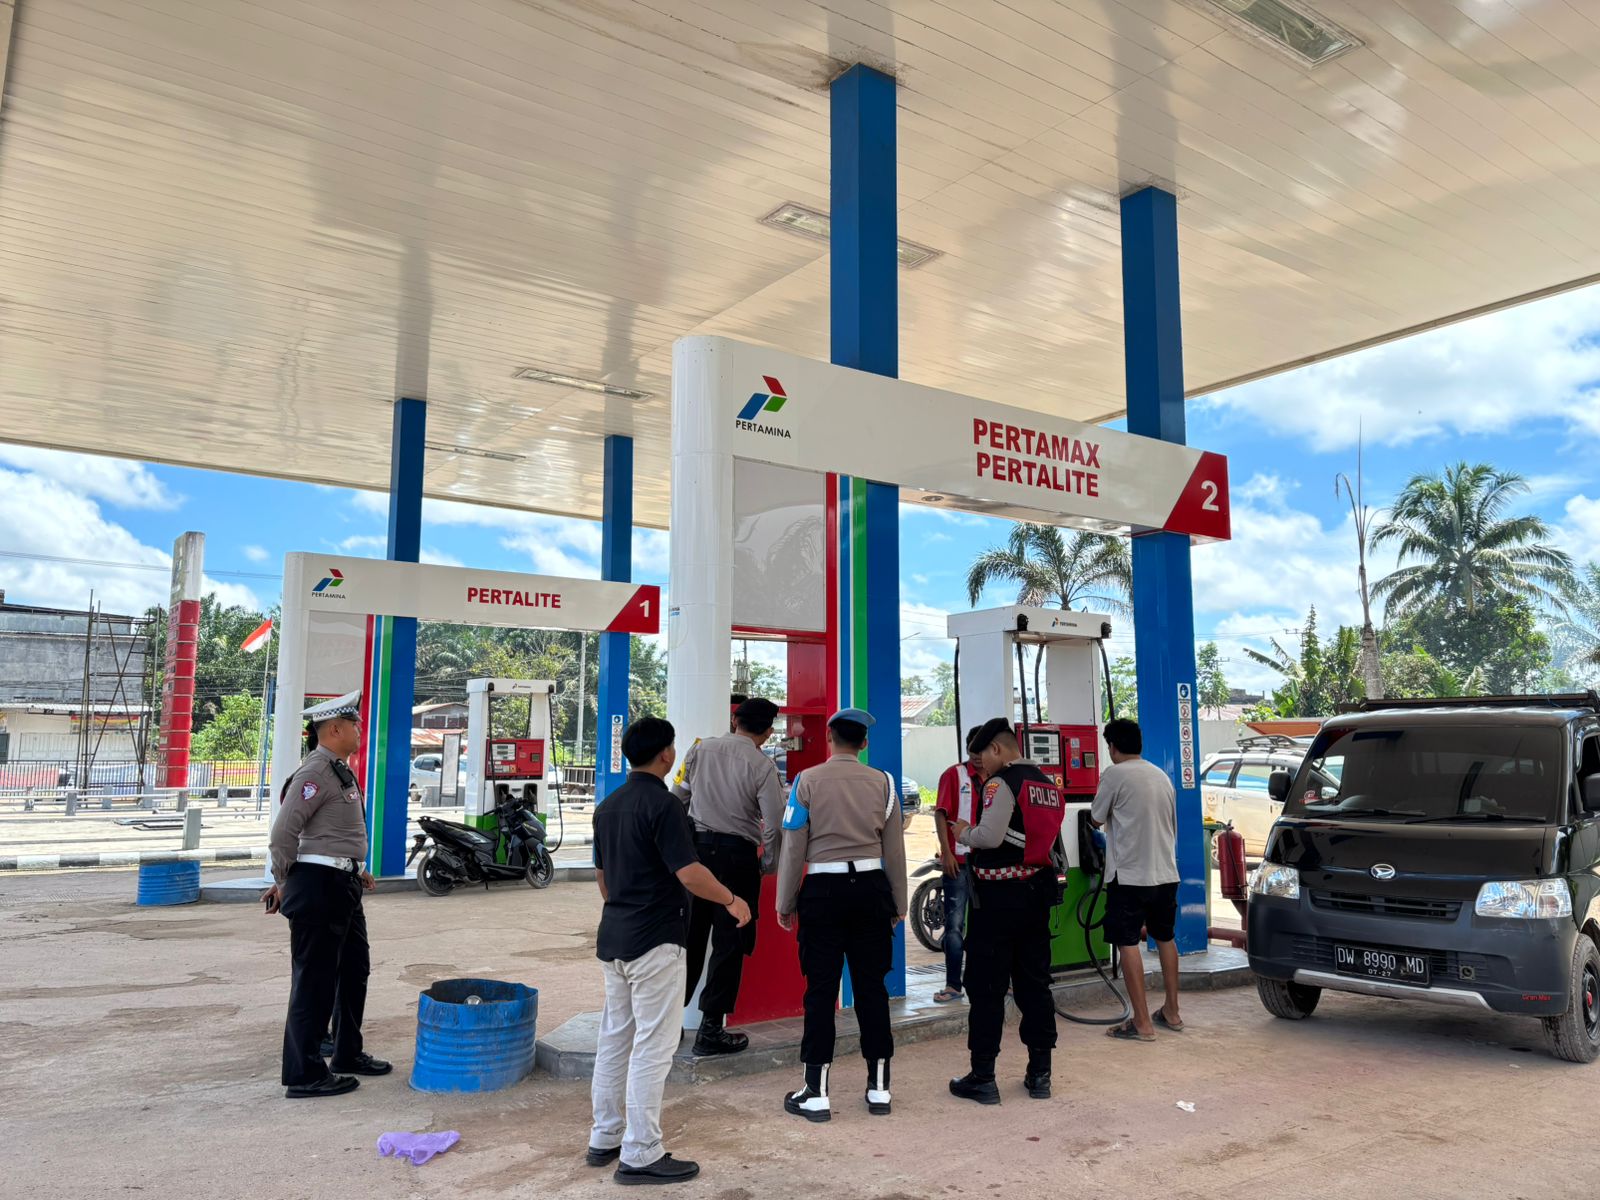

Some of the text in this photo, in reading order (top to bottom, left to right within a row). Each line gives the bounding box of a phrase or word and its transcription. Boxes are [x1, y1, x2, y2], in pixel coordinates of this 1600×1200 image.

[735, 419, 791, 439] PERTAMINA
[973, 417, 1100, 469] PERTAMAX
[976, 451, 1099, 498] PERTALITE
[1201, 480, 1219, 512] 2
[311, 591, 346, 600] PERTAMINA
[467, 586, 561, 609] PERTALITE
[639, 599, 650, 618] 1
[1028, 785, 1060, 808] POLISI
[1337, 947, 1425, 974] DW 8990 MD
